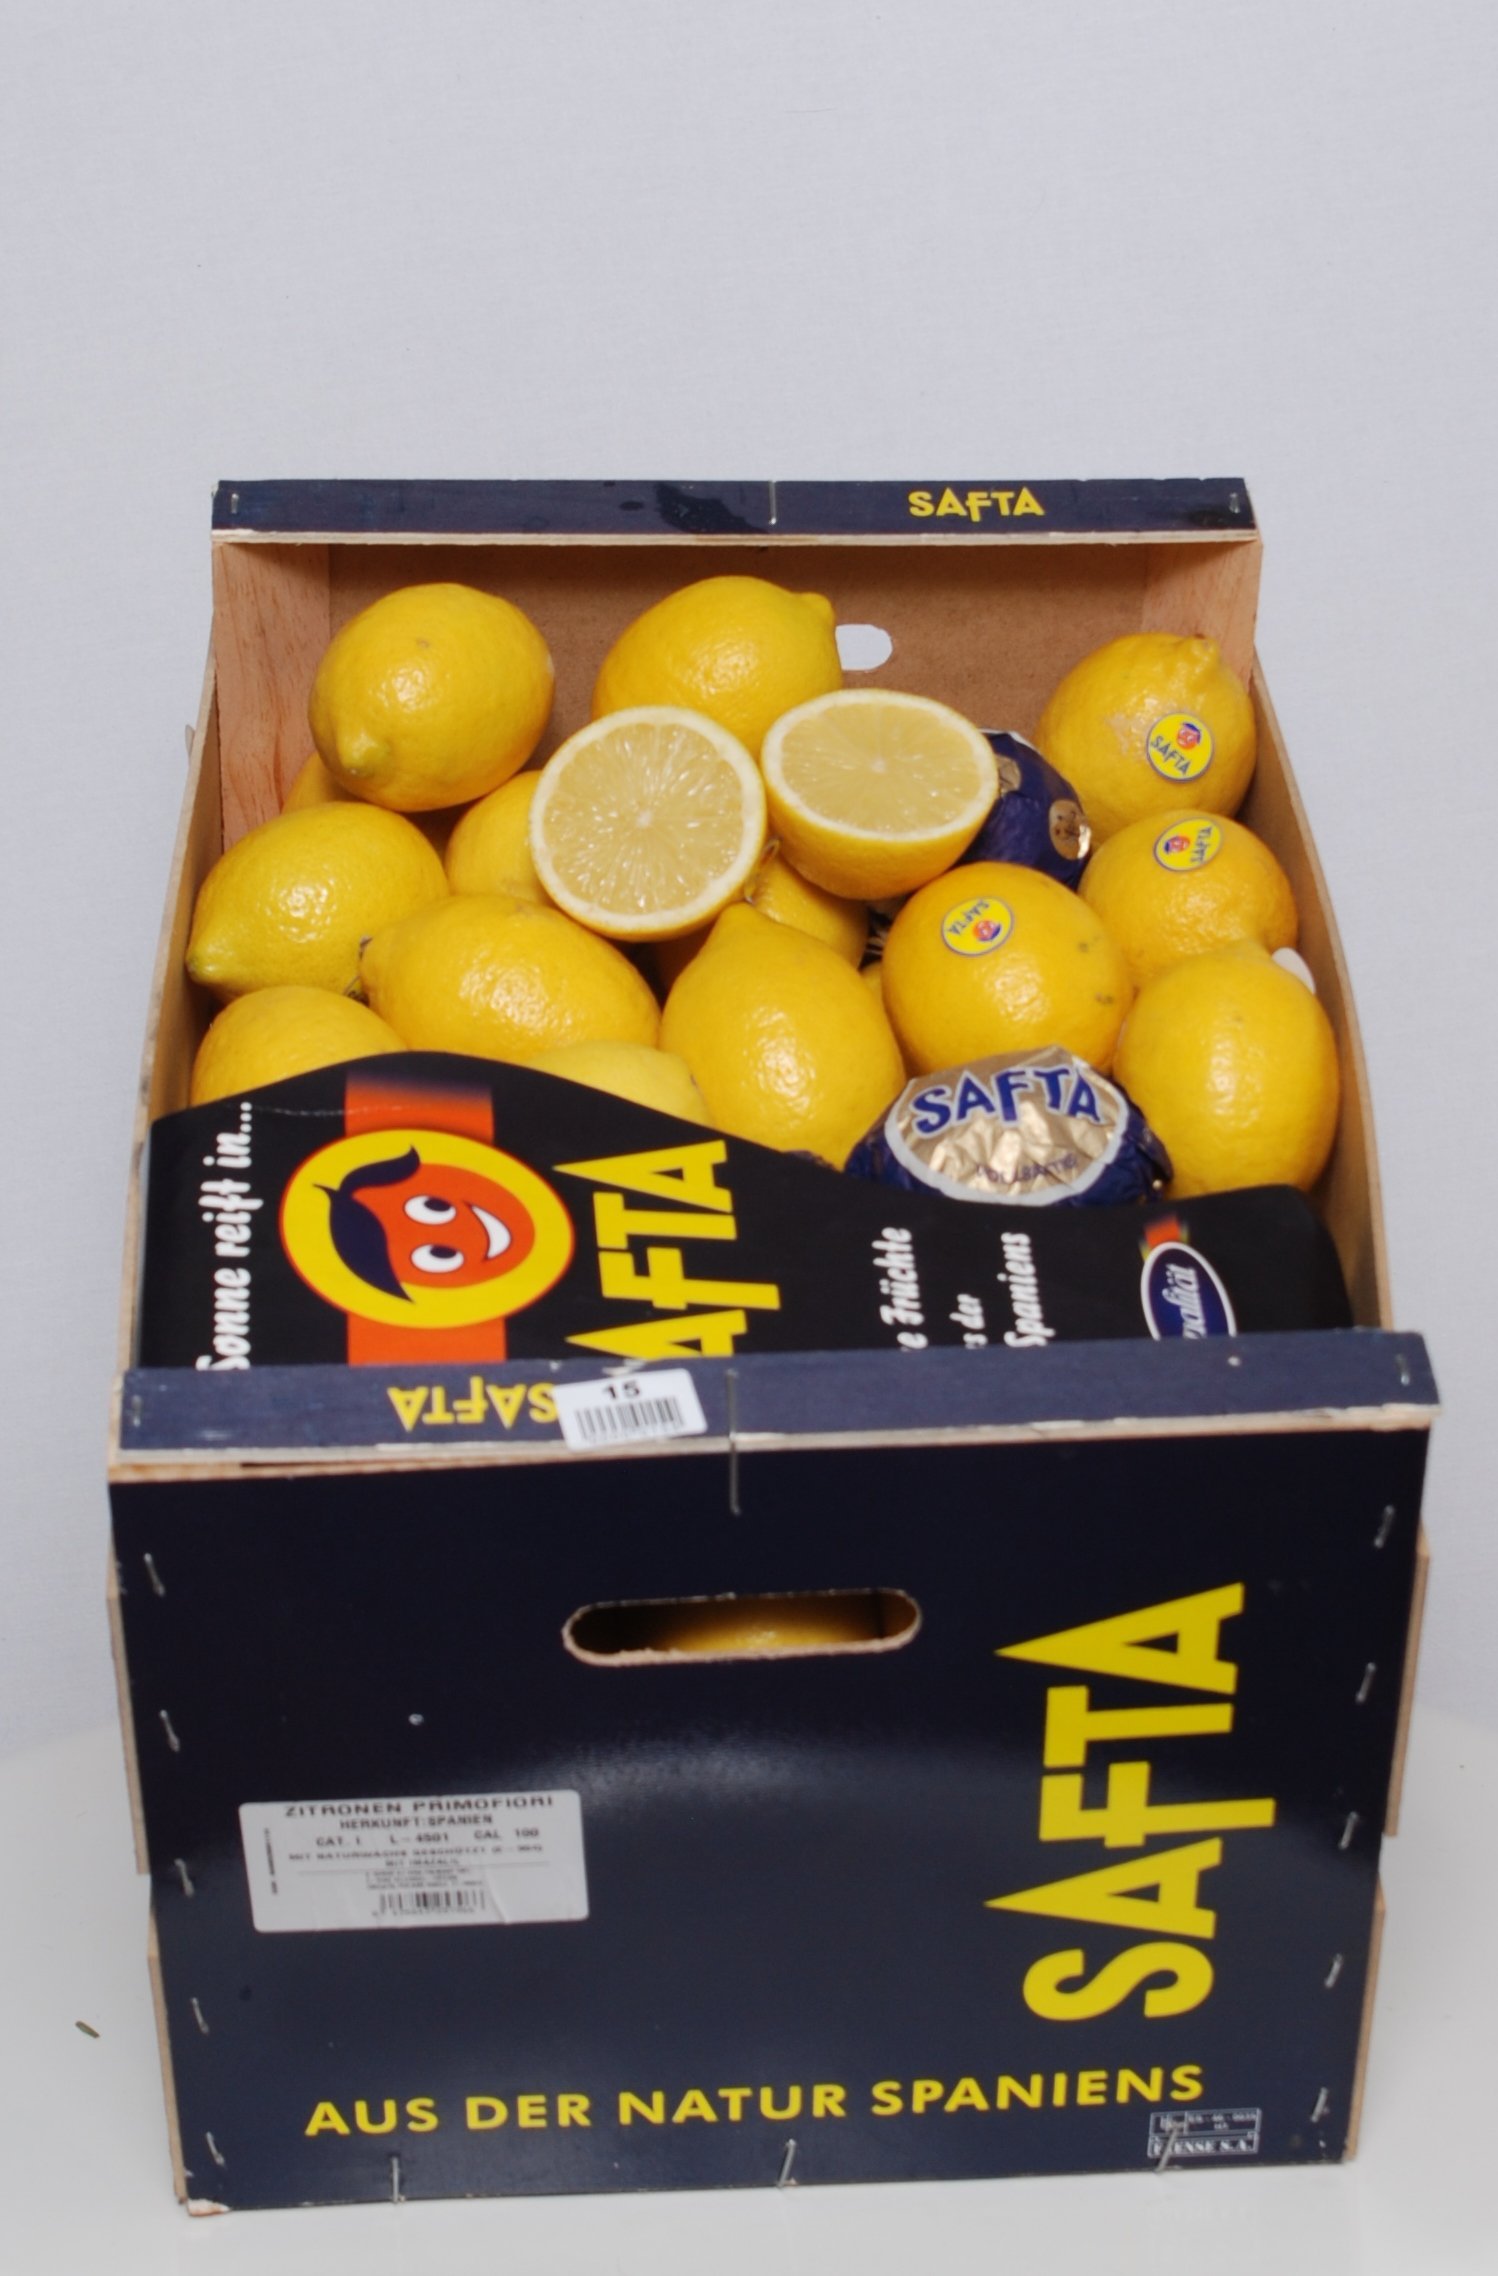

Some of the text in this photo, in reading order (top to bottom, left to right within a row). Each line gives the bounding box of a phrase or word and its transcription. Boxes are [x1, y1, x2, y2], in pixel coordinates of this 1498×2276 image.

[908, 487, 1045, 522] SAFTA
[1150, 735, 1191, 776] SAFTA
[945, 899, 990, 936] SAFTA
[911, 1067, 1103, 1136] SAFTA
[198, 1178, 264, 1257] reift
[871, 1226, 925, 1326] Früchte
[997, 1232, 1056, 1348] Spaniens
[949, 1293, 985, 1330] der
[387, 1376, 558, 1432] SAFTA
[603, 1380, 641, 1399] 15
[285, 1796, 553, 1817] ZITRONEN PRIMOFIORI
[985, 1582, 1276, 2022] SAFTA
[305, 2064, 1203, 2136] AUS DER NATUR SPANIENS
